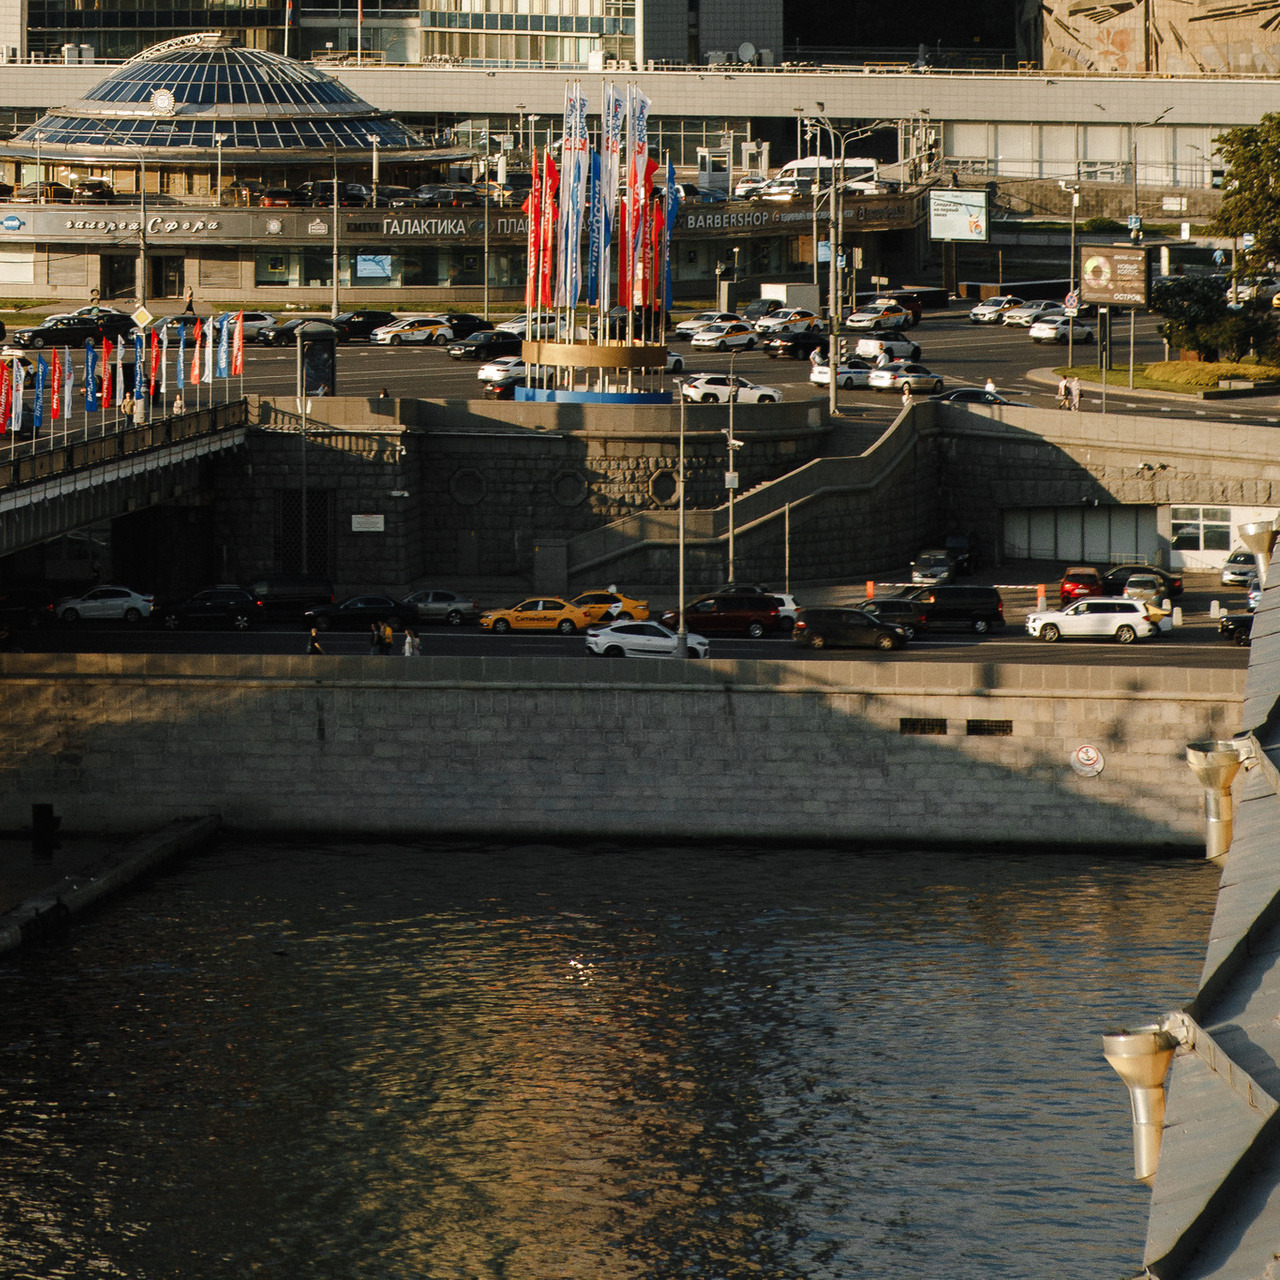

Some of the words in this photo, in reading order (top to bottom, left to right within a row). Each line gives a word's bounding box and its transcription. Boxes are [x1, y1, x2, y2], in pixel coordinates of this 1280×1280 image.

[64, 220, 141, 234] галерея
[147, 217, 219, 234] Сфера
[383, 218, 466, 235] ГАЛАКТИКА
[687, 211, 768, 229] BARBERSHOP
[1113, 292, 1141, 302] ОСТРОВ
